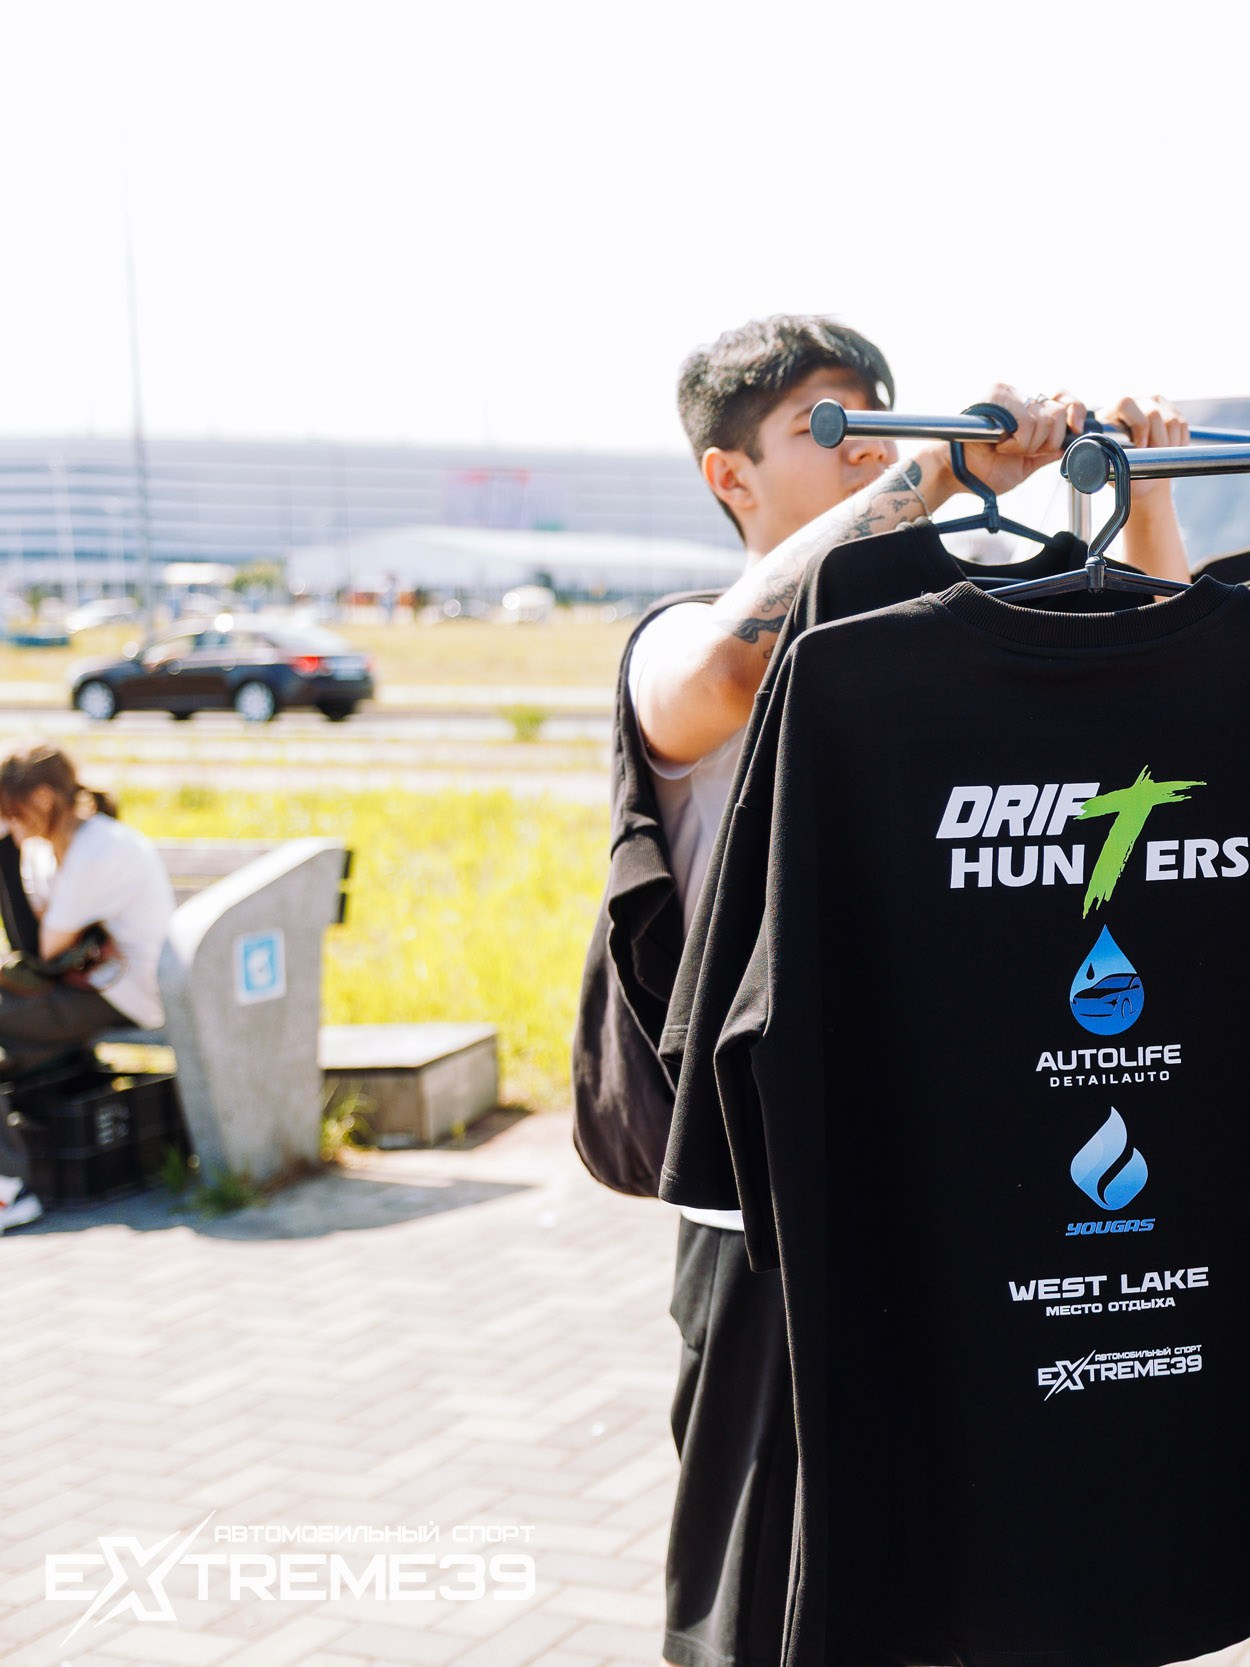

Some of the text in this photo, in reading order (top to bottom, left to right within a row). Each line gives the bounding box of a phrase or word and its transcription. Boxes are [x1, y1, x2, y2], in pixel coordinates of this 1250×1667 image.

[1036, 1044, 1182, 1072] AUTOLIFE
[1050, 1070, 1170, 1088] DETAILAUTO
[1065, 1218, 1156, 1237] YOUGAS
[1009, 1266, 1209, 1301] WEST LAKE
[1045, 1296, 1176, 1317] МЕСТО ОТДЫХА
[1094, 1344, 1203, 1362] АВТОМОБИЛЬНЫЙ СПОРТ
[1037, 1350, 1203, 1402] EXTREME39
